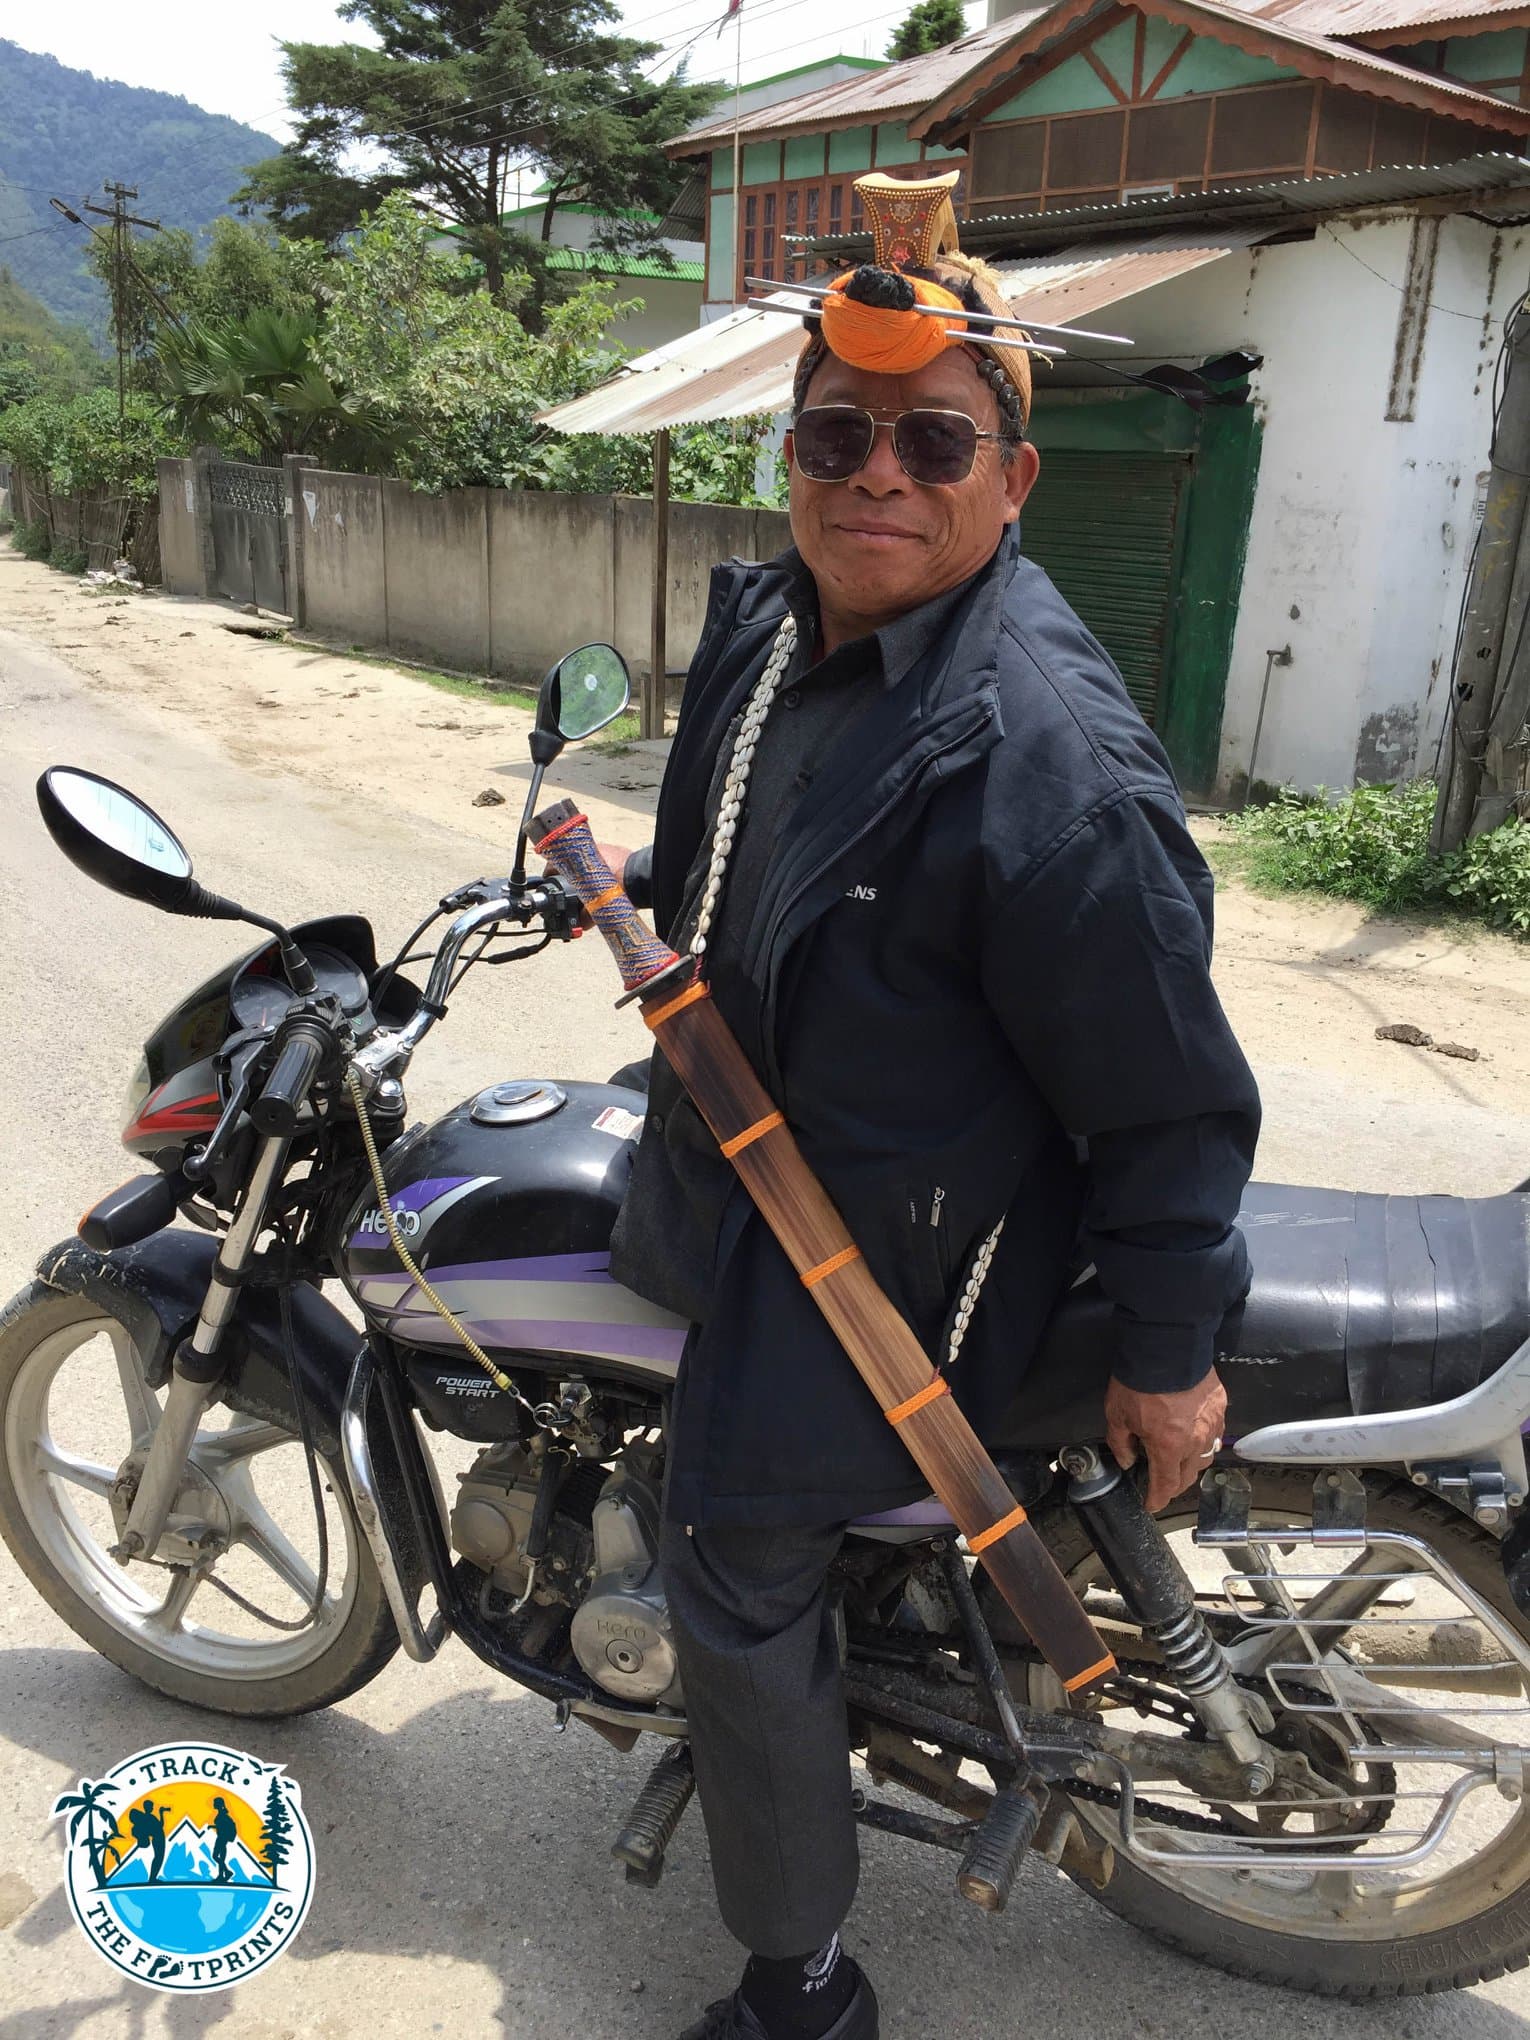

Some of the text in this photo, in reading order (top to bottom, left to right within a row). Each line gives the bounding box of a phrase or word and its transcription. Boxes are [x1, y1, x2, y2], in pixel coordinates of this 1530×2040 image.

[435, 1376, 493, 1389] POWER
[445, 1386, 501, 1399] START
[596, 1619, 646, 1640] Hero
